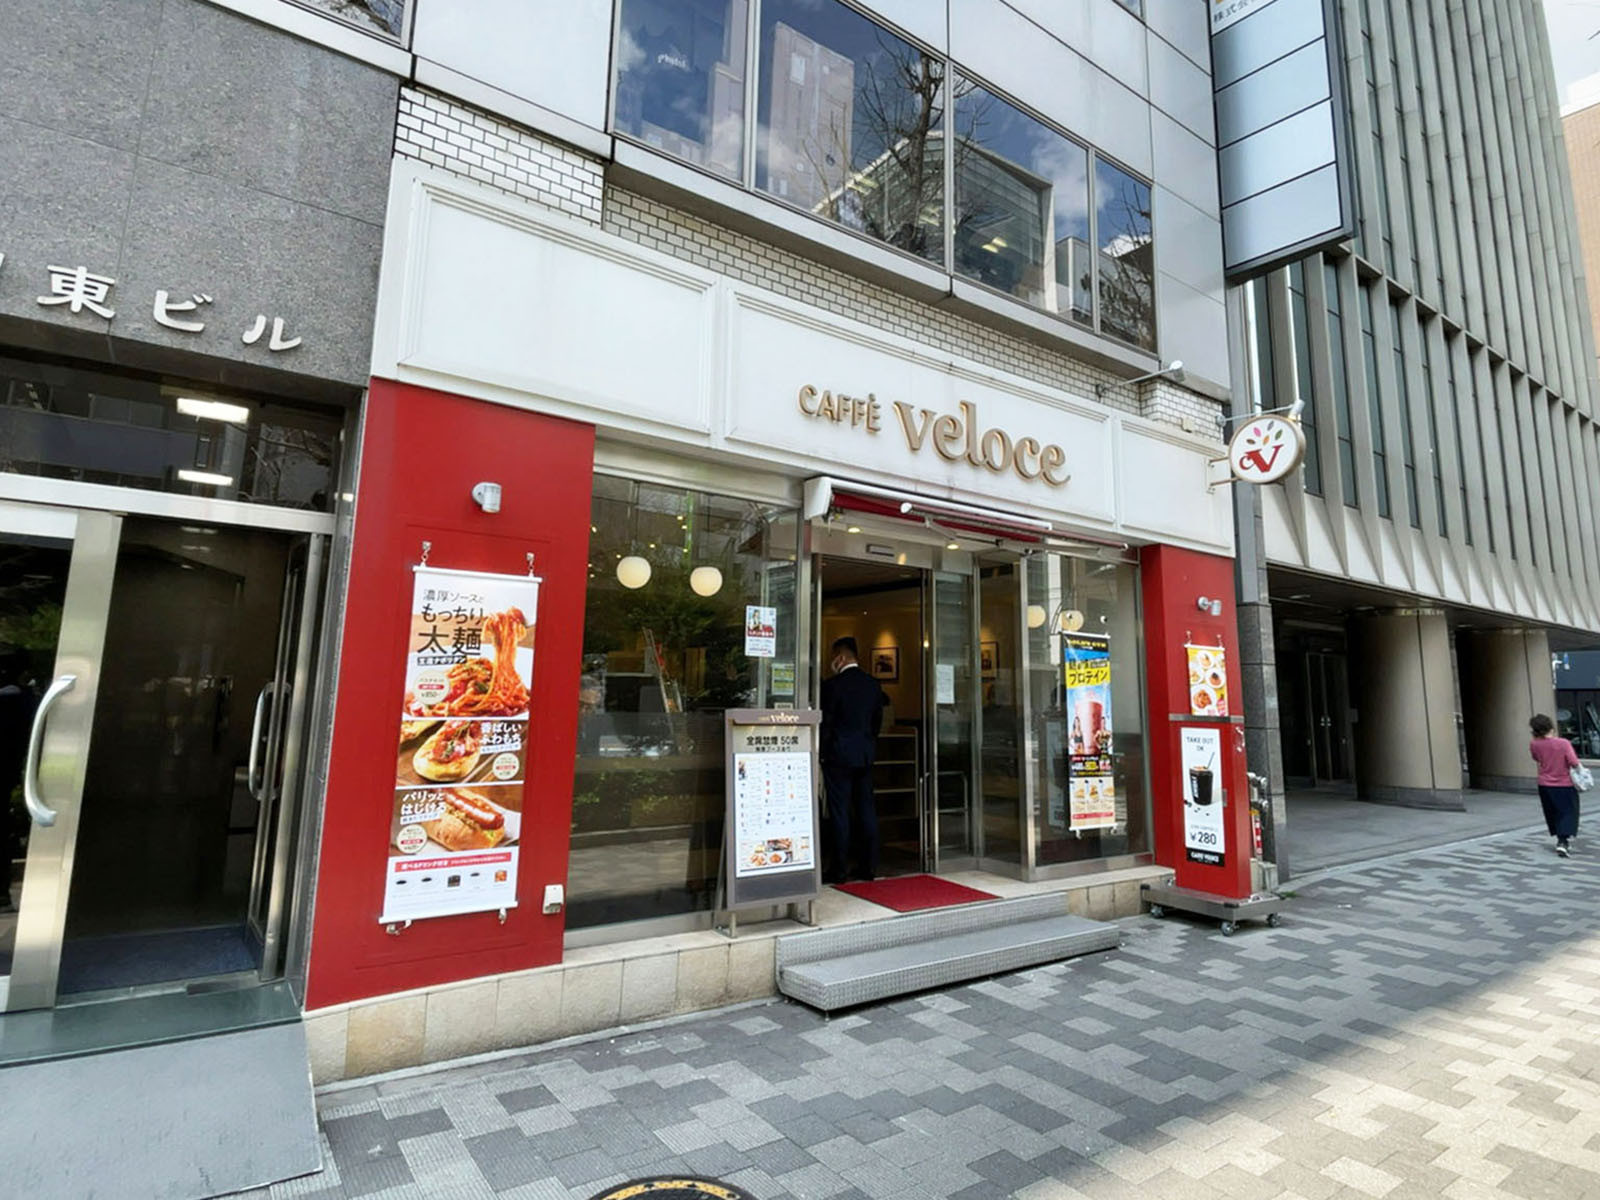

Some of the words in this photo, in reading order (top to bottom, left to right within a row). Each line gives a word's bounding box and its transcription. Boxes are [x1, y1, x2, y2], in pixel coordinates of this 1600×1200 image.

[0, 252, 303, 351] 東ビル
[893, 399, 1071, 488] veloce
[421, 603, 485, 626] もっちり
[417, 625, 483, 656] 太麺
[1068, 669, 1108, 686] プロテイン
[481, 721, 523, 735] 香ばしい
[481, 732, 522, 746] ふわもち
[401, 801, 447, 816] はじける
